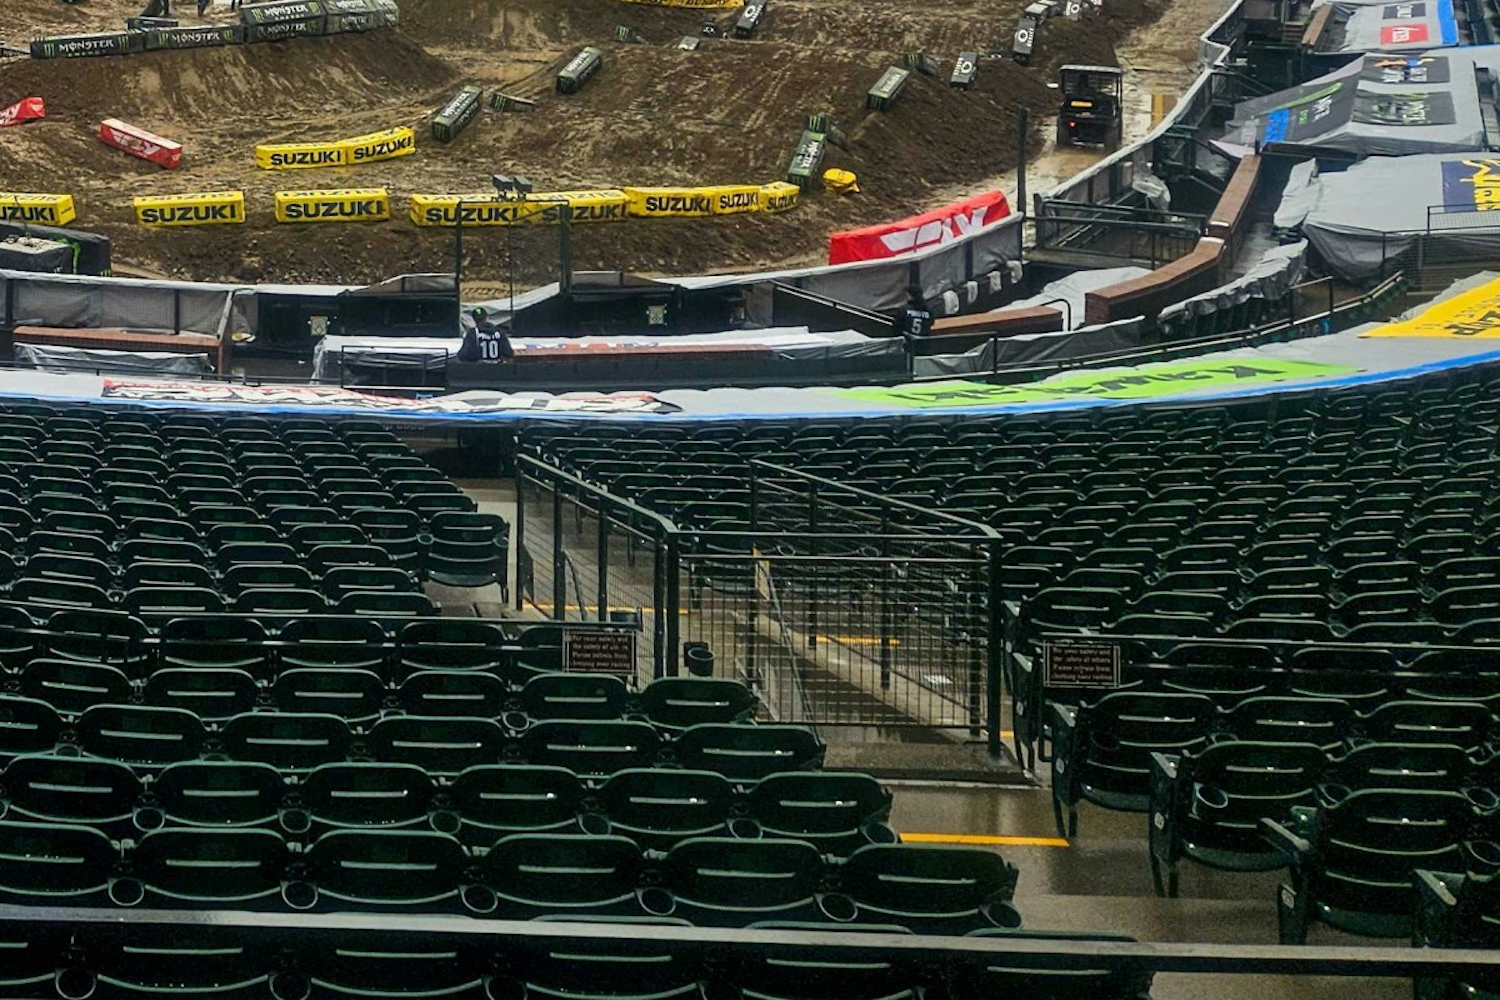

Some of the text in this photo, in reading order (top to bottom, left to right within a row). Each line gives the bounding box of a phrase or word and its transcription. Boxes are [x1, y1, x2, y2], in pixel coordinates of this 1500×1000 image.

[264, 5, 307, 17] MONSTER
[58, 39, 114, 52] MONSTER
[171, 31, 220, 44] MONSTER
[354, 137, 412, 160] SUZUKI
[270, 151, 341, 166] SUZUKI
[141, 203, 236, 223] SUZUKI
[284, 200, 381, 218] SUZUKI
[646, 197, 711, 213] SUZUKI
[425, 207, 518, 222] SUZUKI
[911, 318, 921, 334] 5
[480, 340, 498, 359] 10
